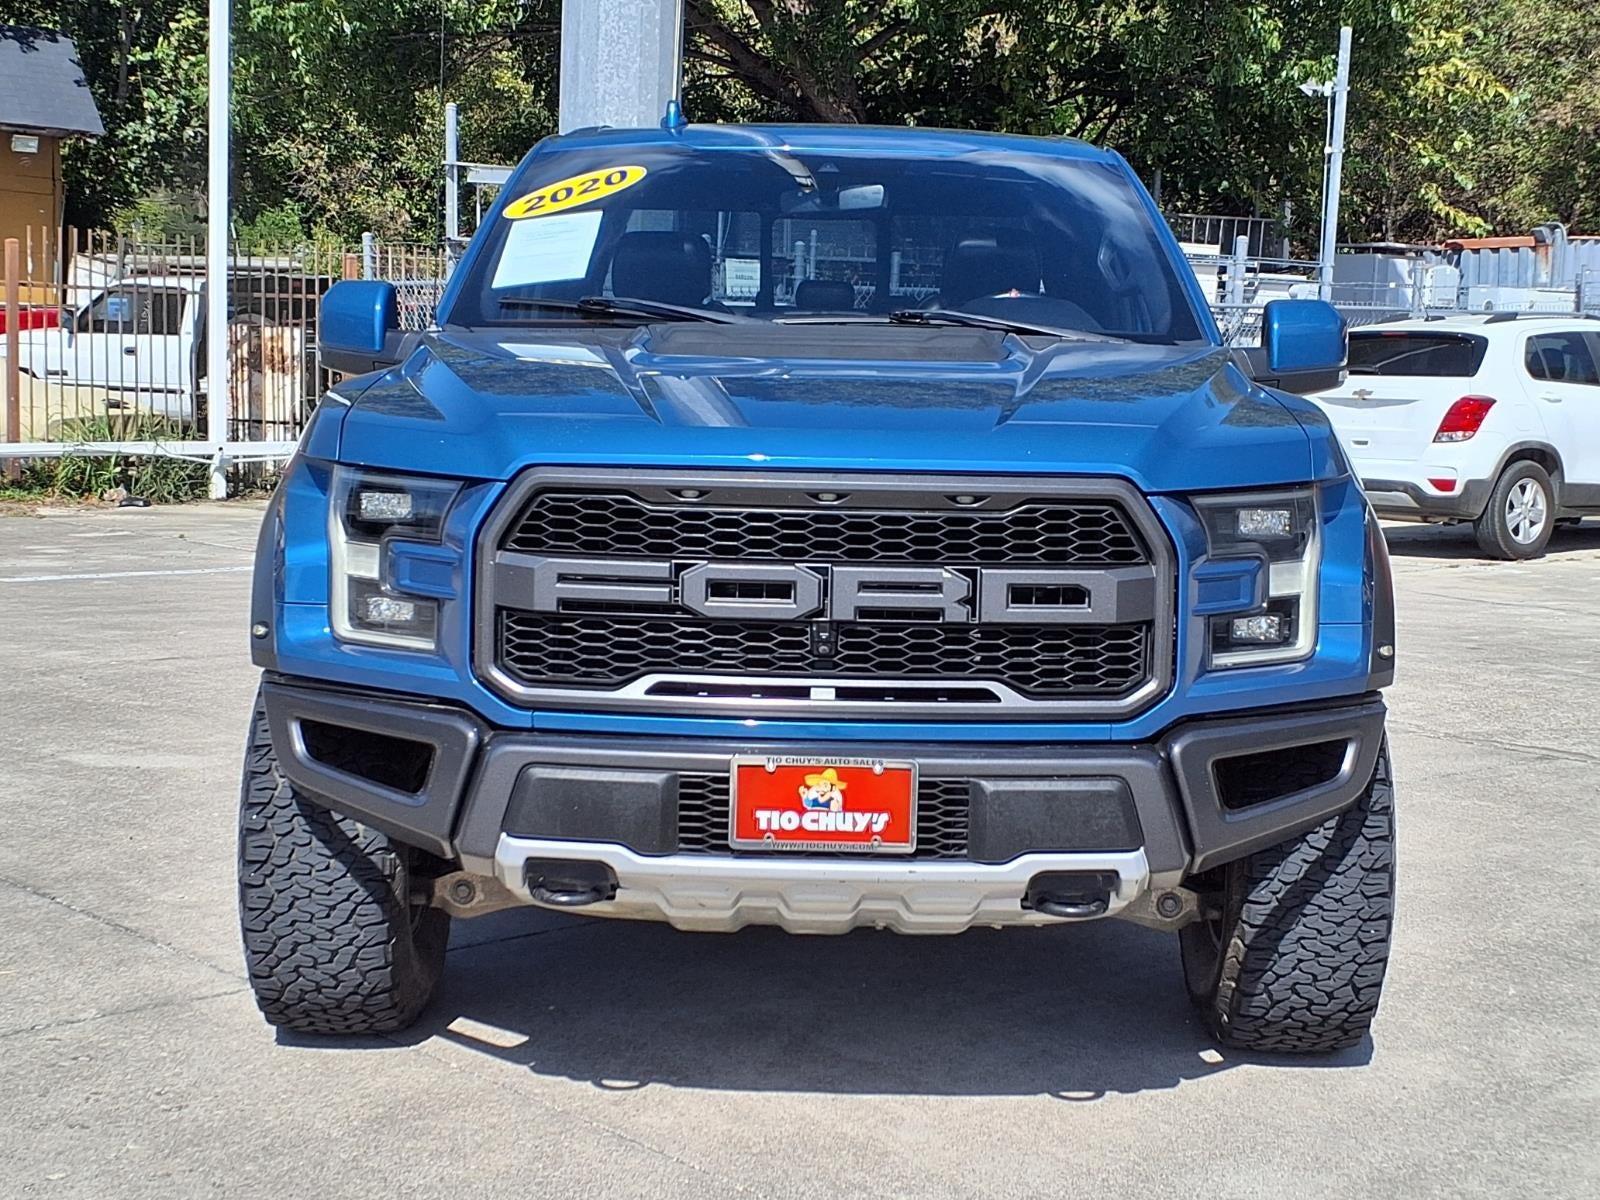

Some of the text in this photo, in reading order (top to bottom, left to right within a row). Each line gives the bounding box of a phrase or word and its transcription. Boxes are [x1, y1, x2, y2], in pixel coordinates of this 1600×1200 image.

[522, 170, 627, 214] 2020
[532, 557, 1120, 626] FORD
[766, 756, 884, 767] TIO CHUY'S AUTO SALES
[755, 810, 889, 832] TIO CHUY'S
